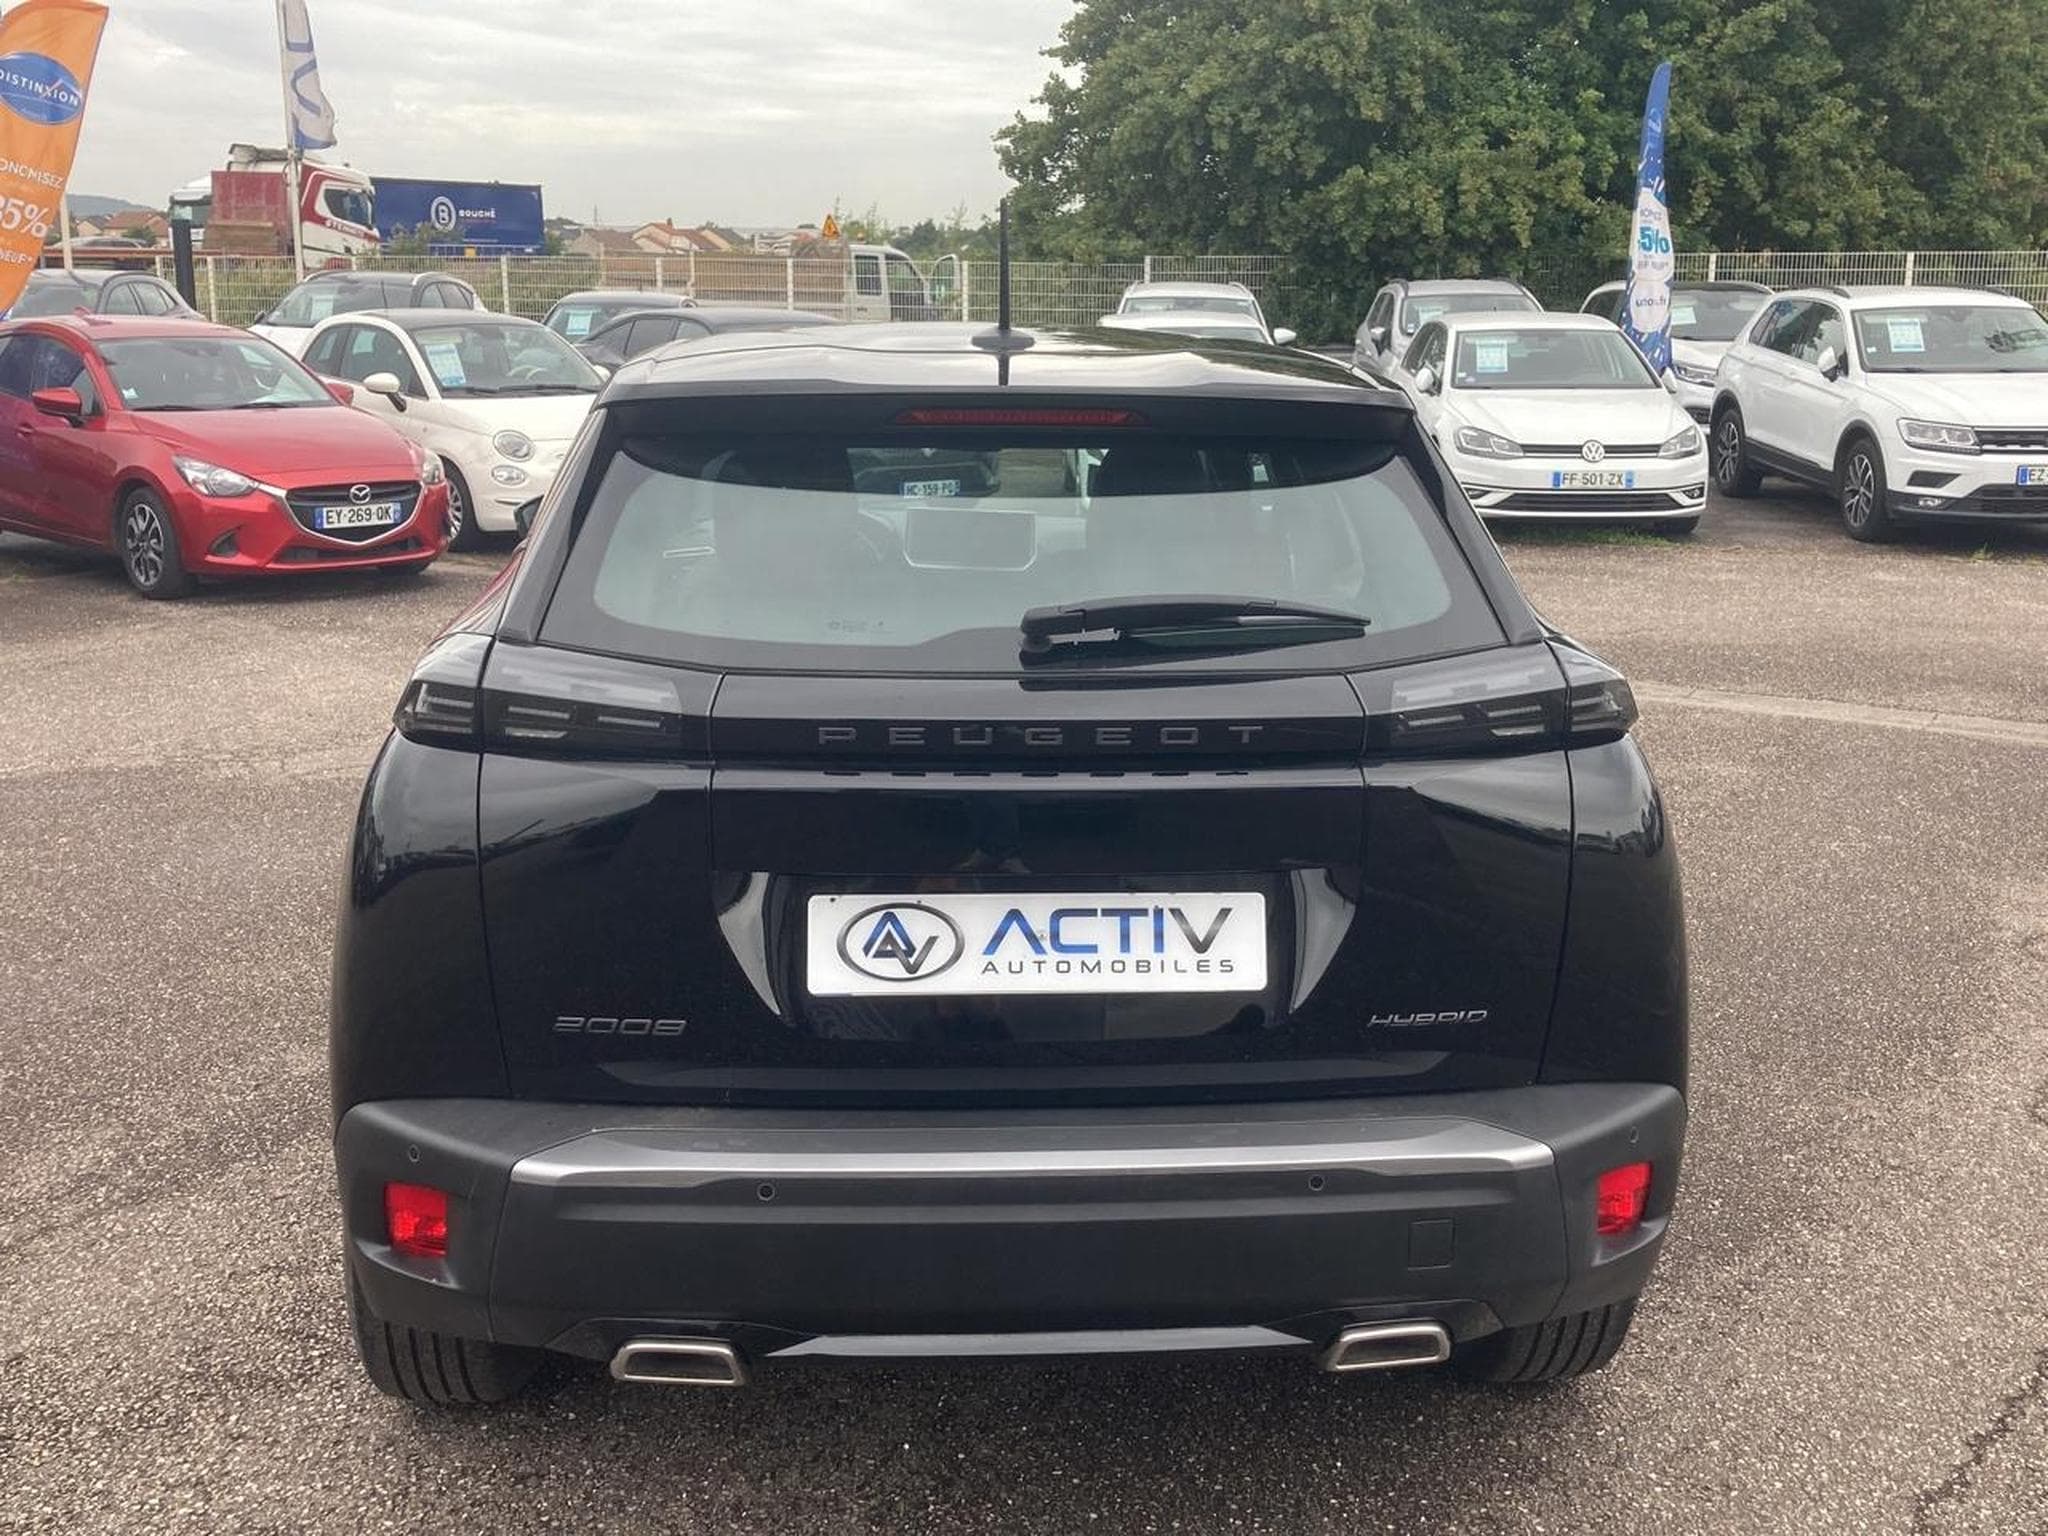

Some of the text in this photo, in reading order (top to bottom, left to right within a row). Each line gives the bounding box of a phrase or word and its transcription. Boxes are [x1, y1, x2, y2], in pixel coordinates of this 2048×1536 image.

[818, 726, 1263, 745] PEUGEOT
[982, 907, 1233, 955] ACTIV
[982, 959, 1234, 975] AUTOMOBILES
[553, 1015, 687, 1036] 2008
[1367, 1010, 1487, 1028] HYBRID
